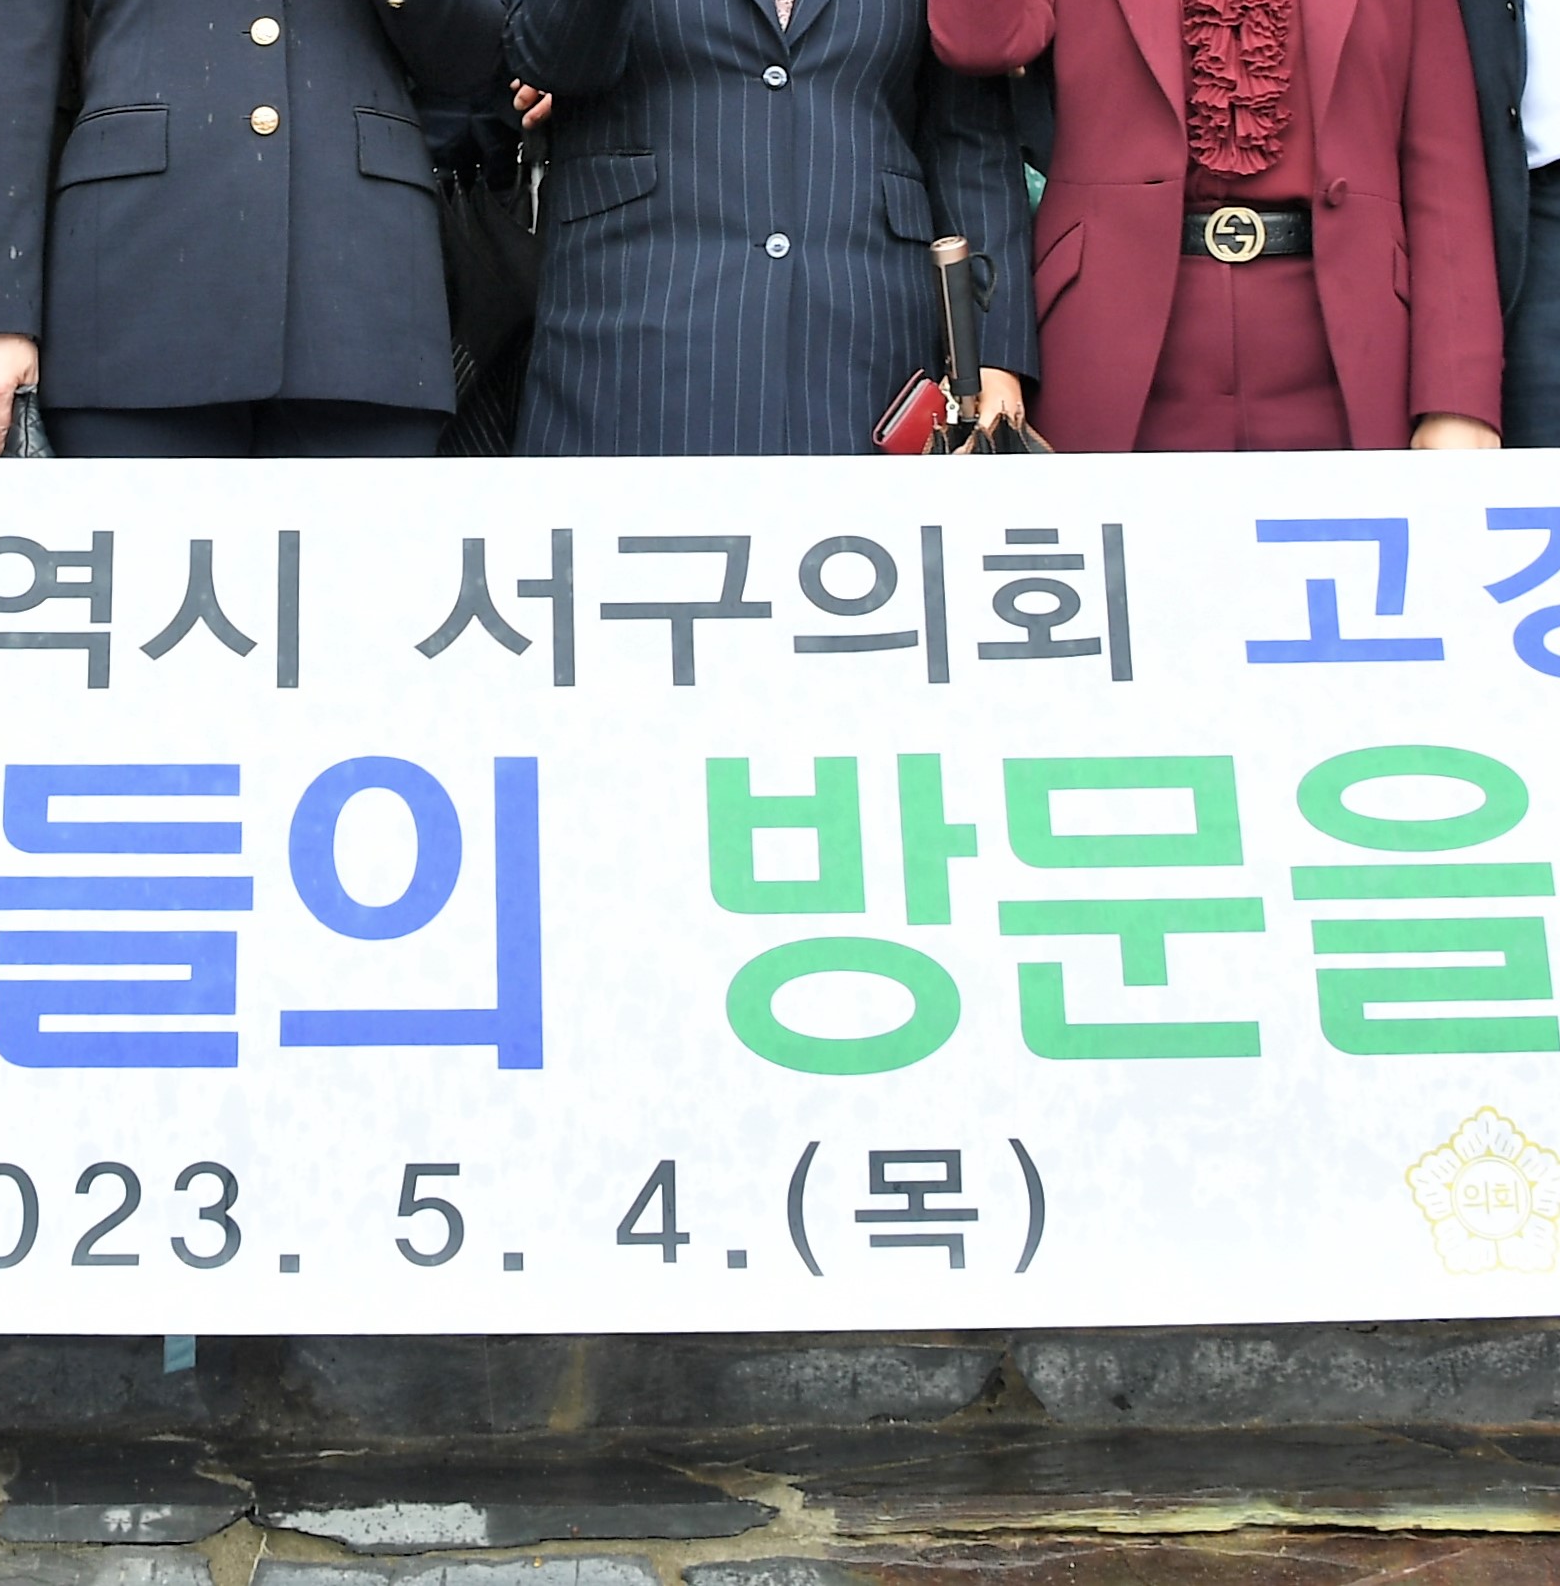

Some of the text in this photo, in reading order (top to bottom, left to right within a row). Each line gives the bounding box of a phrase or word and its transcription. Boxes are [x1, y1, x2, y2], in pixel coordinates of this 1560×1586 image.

[416, 524, 1135, 689] 서구의회
[395, 1162, 525, 1274] 5.
[1462, 1180, 1520, 1215] 의회
